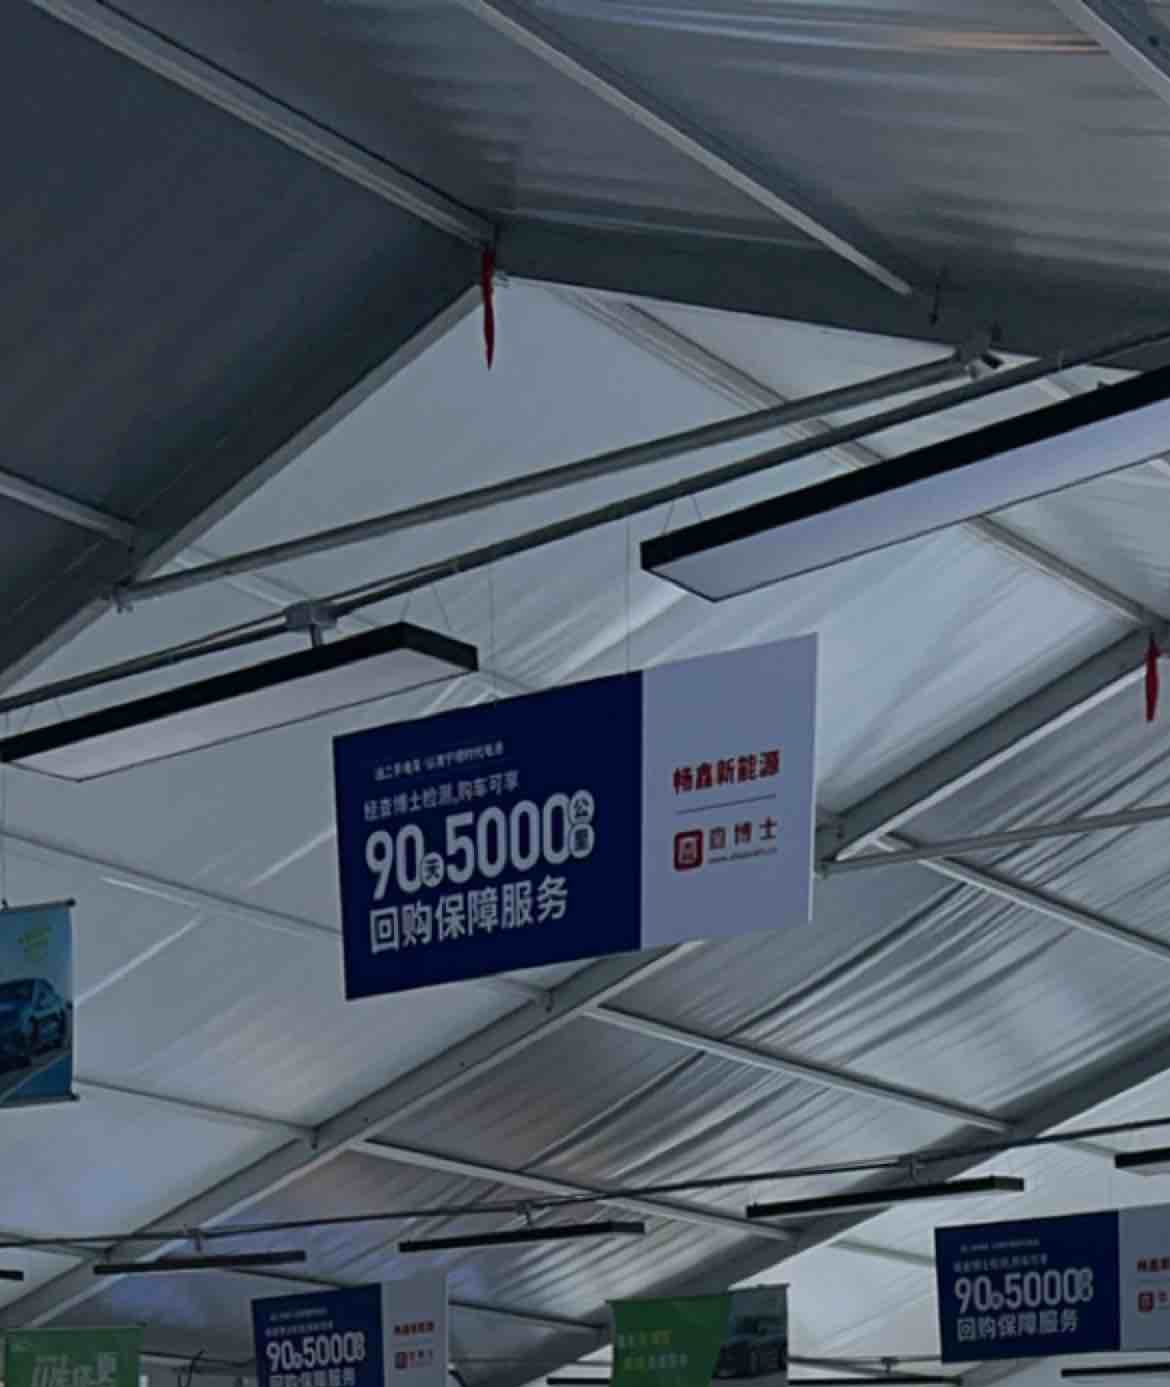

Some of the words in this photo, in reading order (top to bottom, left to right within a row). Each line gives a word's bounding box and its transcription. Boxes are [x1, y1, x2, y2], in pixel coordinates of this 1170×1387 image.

[672, 750, 780, 795] 畅鑫新能源
[369, 876, 568, 954] 回购保障服务
[266, 1331, 366, 1372] 905000
